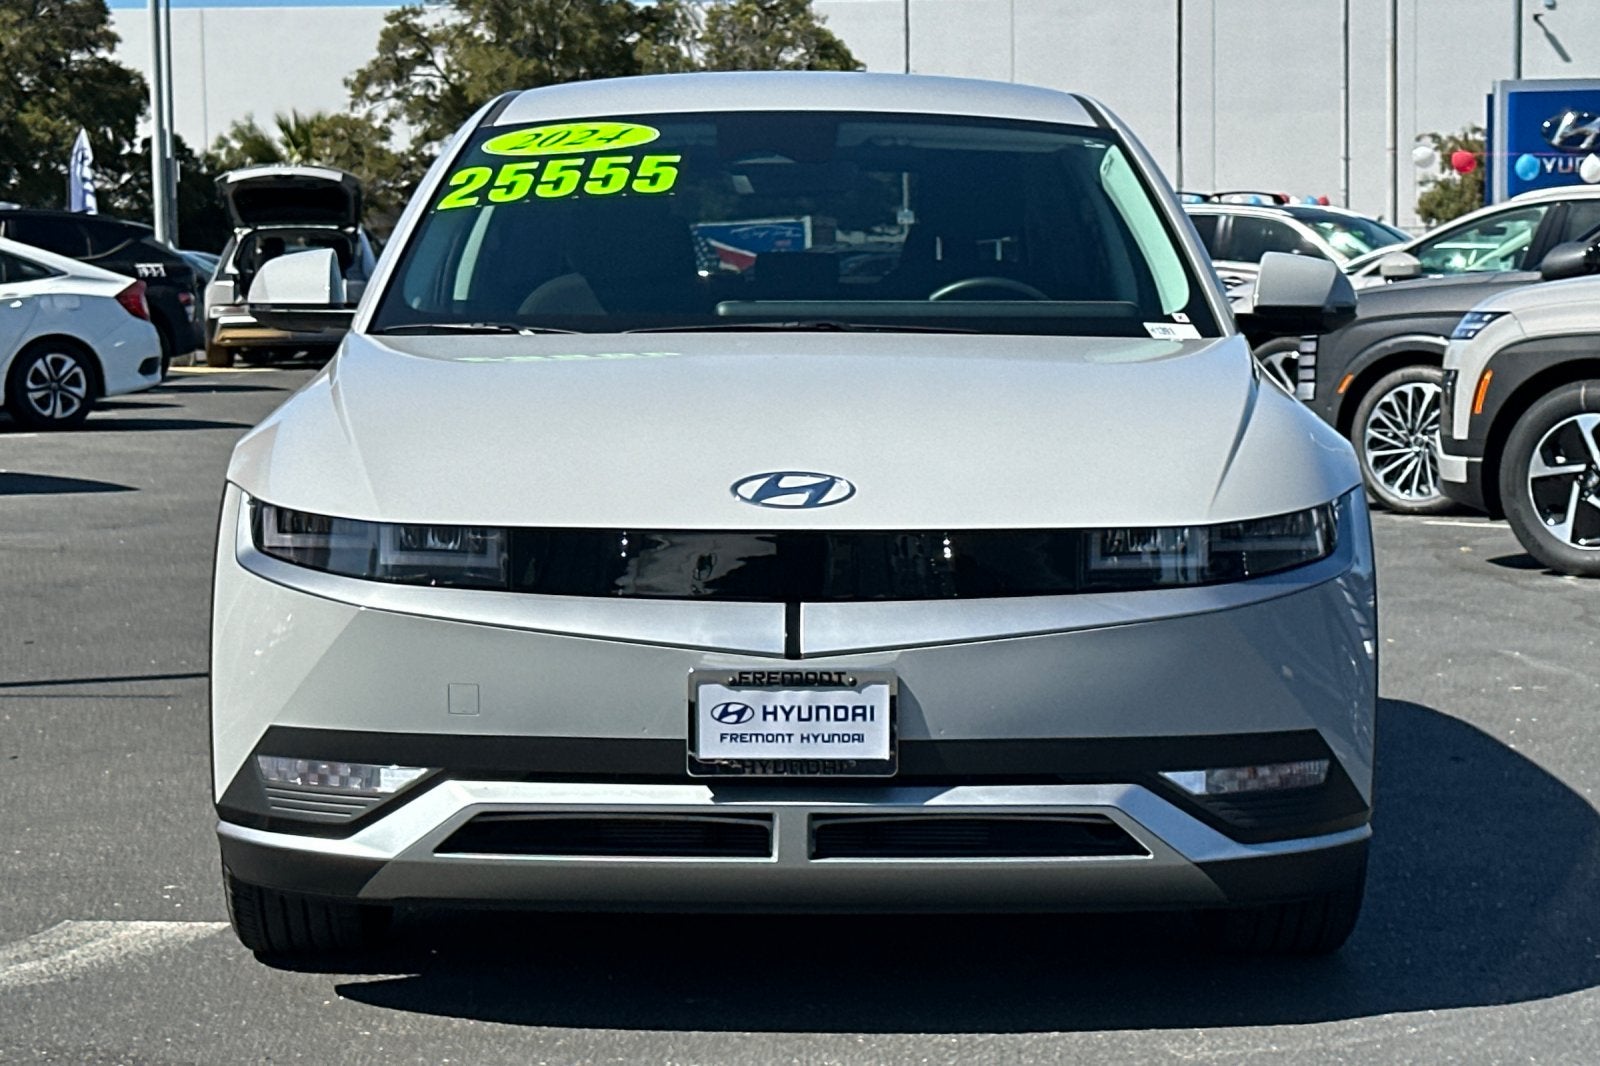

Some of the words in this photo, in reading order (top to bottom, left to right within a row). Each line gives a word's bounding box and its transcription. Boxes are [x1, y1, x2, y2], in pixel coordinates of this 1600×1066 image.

[507, 127, 634, 151] 2024
[436, 155, 682, 210] 25555
[762, 705, 875, 722] HYUNDAI
[720, 733, 794, 743] FREMONT
[800, 733, 864, 743] HYUNDAI
